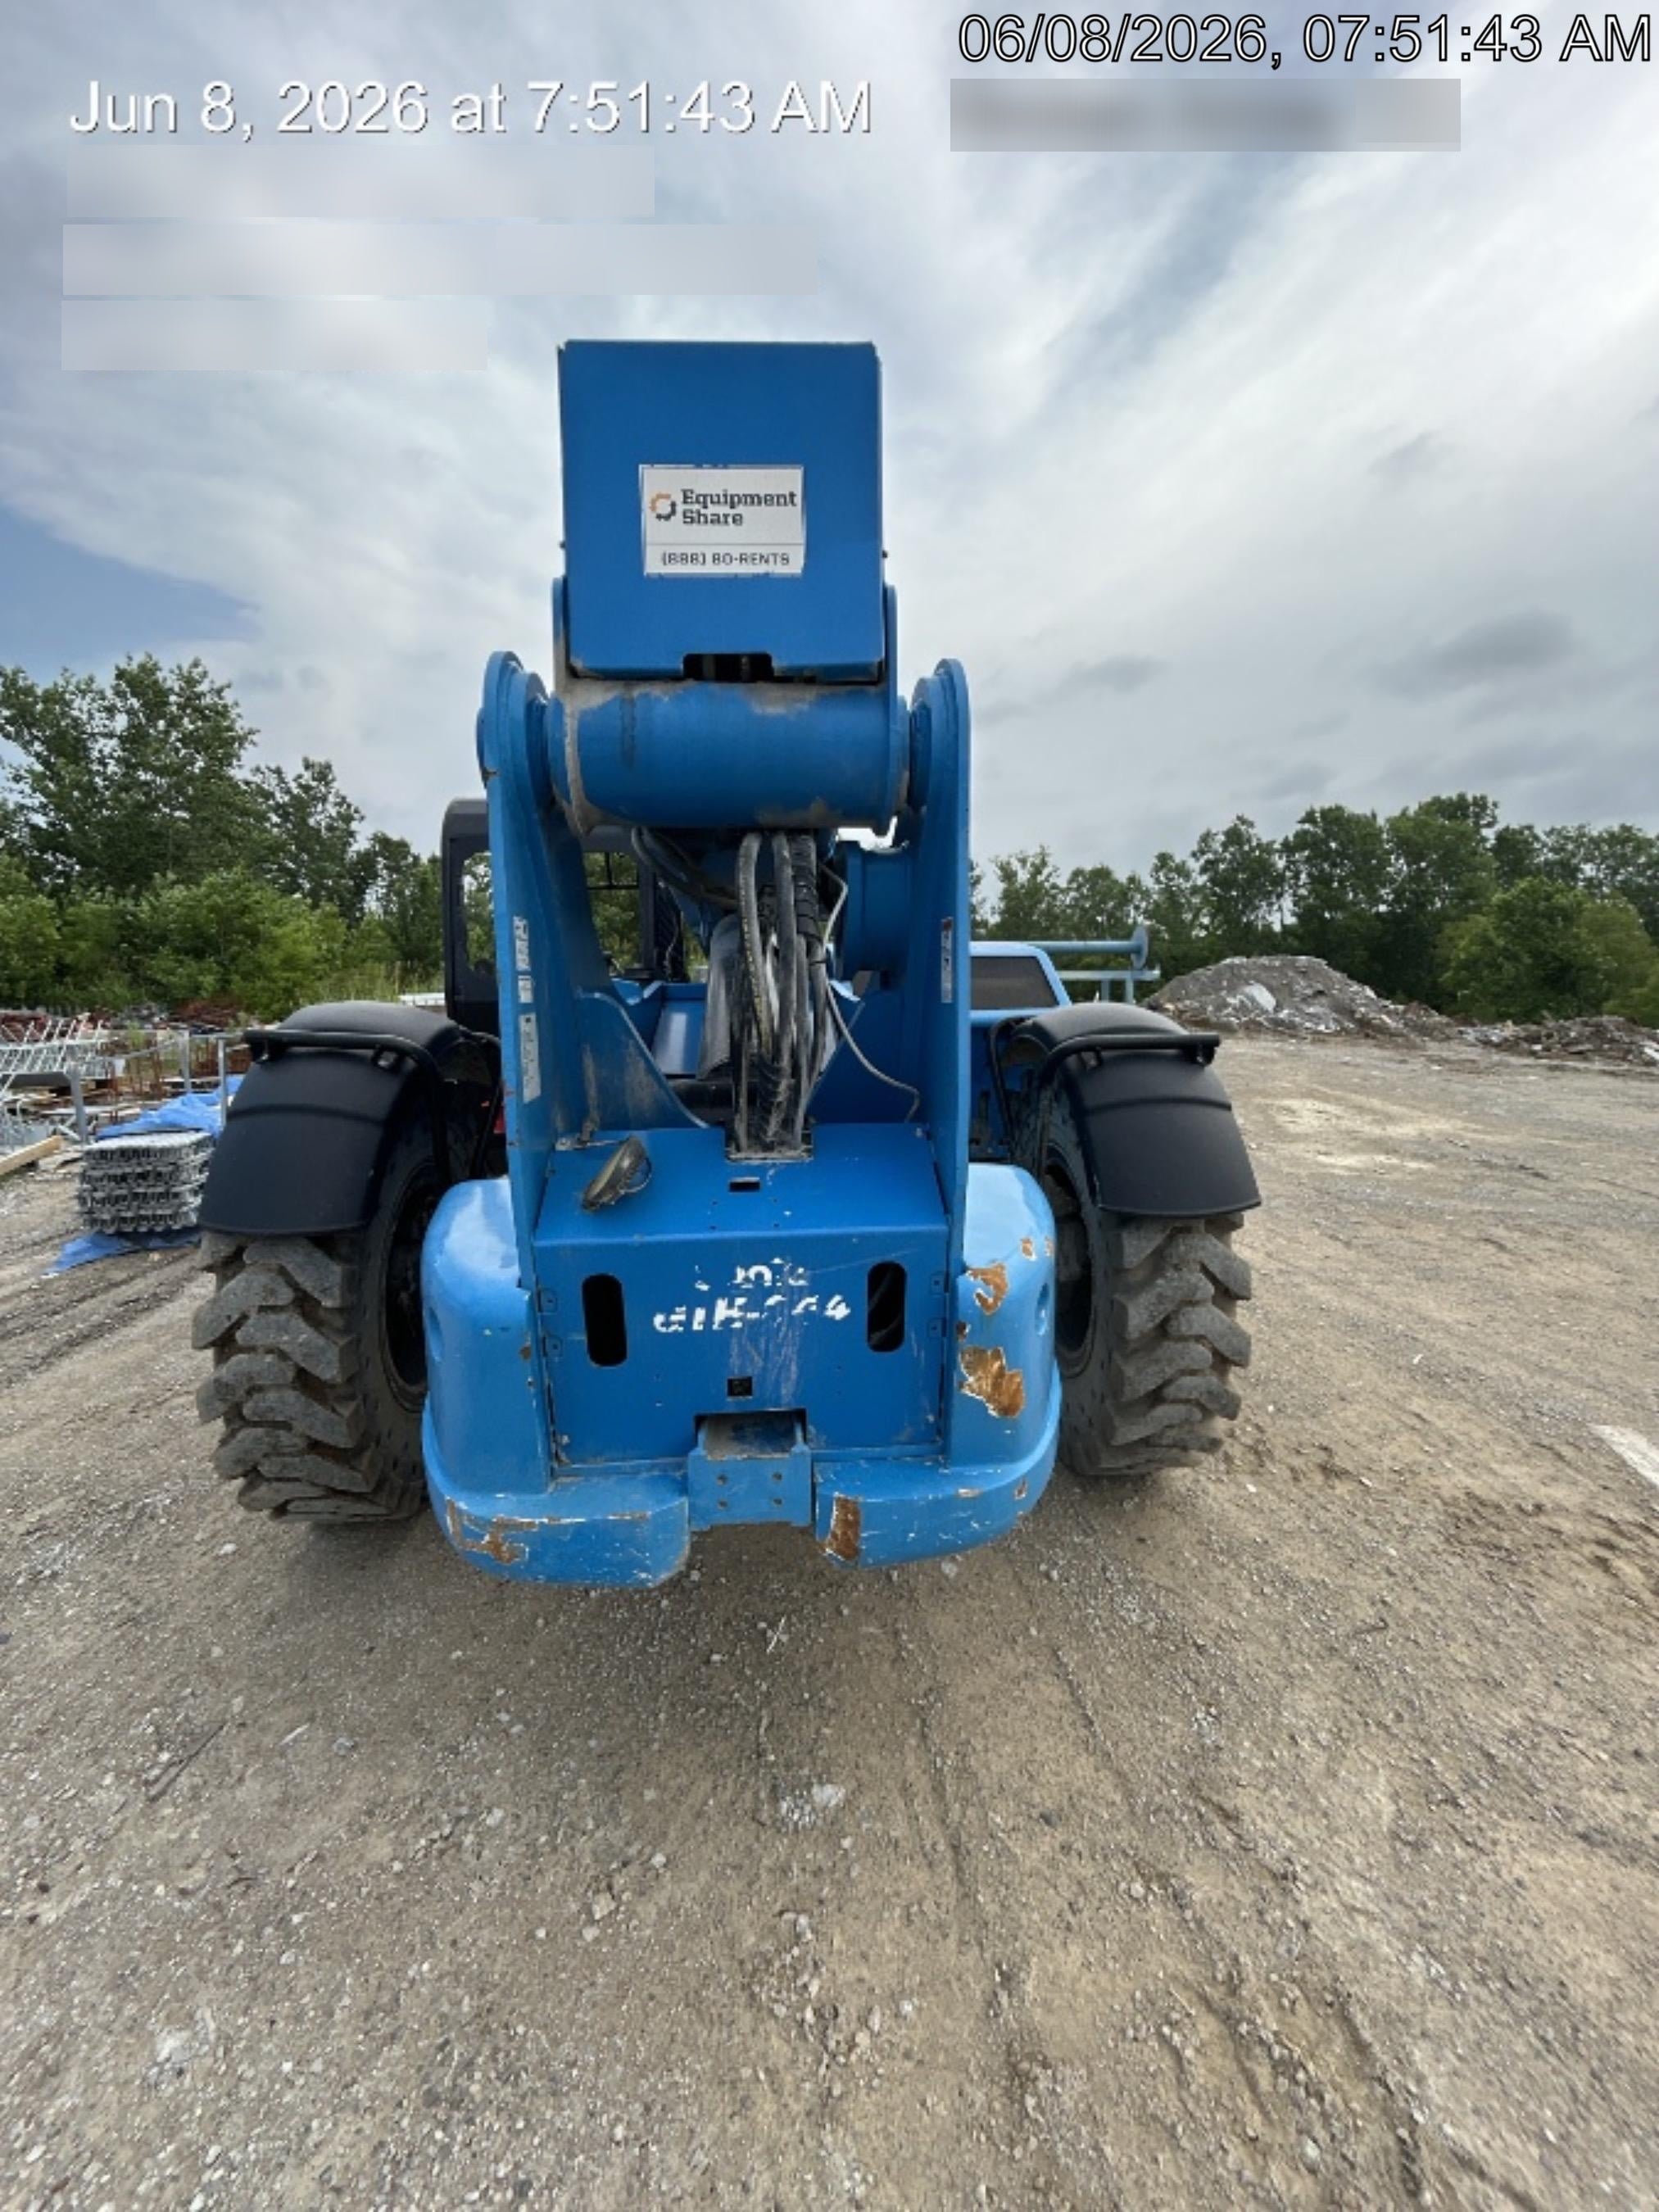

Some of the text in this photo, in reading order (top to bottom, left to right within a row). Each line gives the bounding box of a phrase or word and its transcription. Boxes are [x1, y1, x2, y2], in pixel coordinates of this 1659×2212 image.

[681, 489, 797, 509] Equipment
[682, 510, 744, 526] Share
[662, 552, 707, 566] (888)
